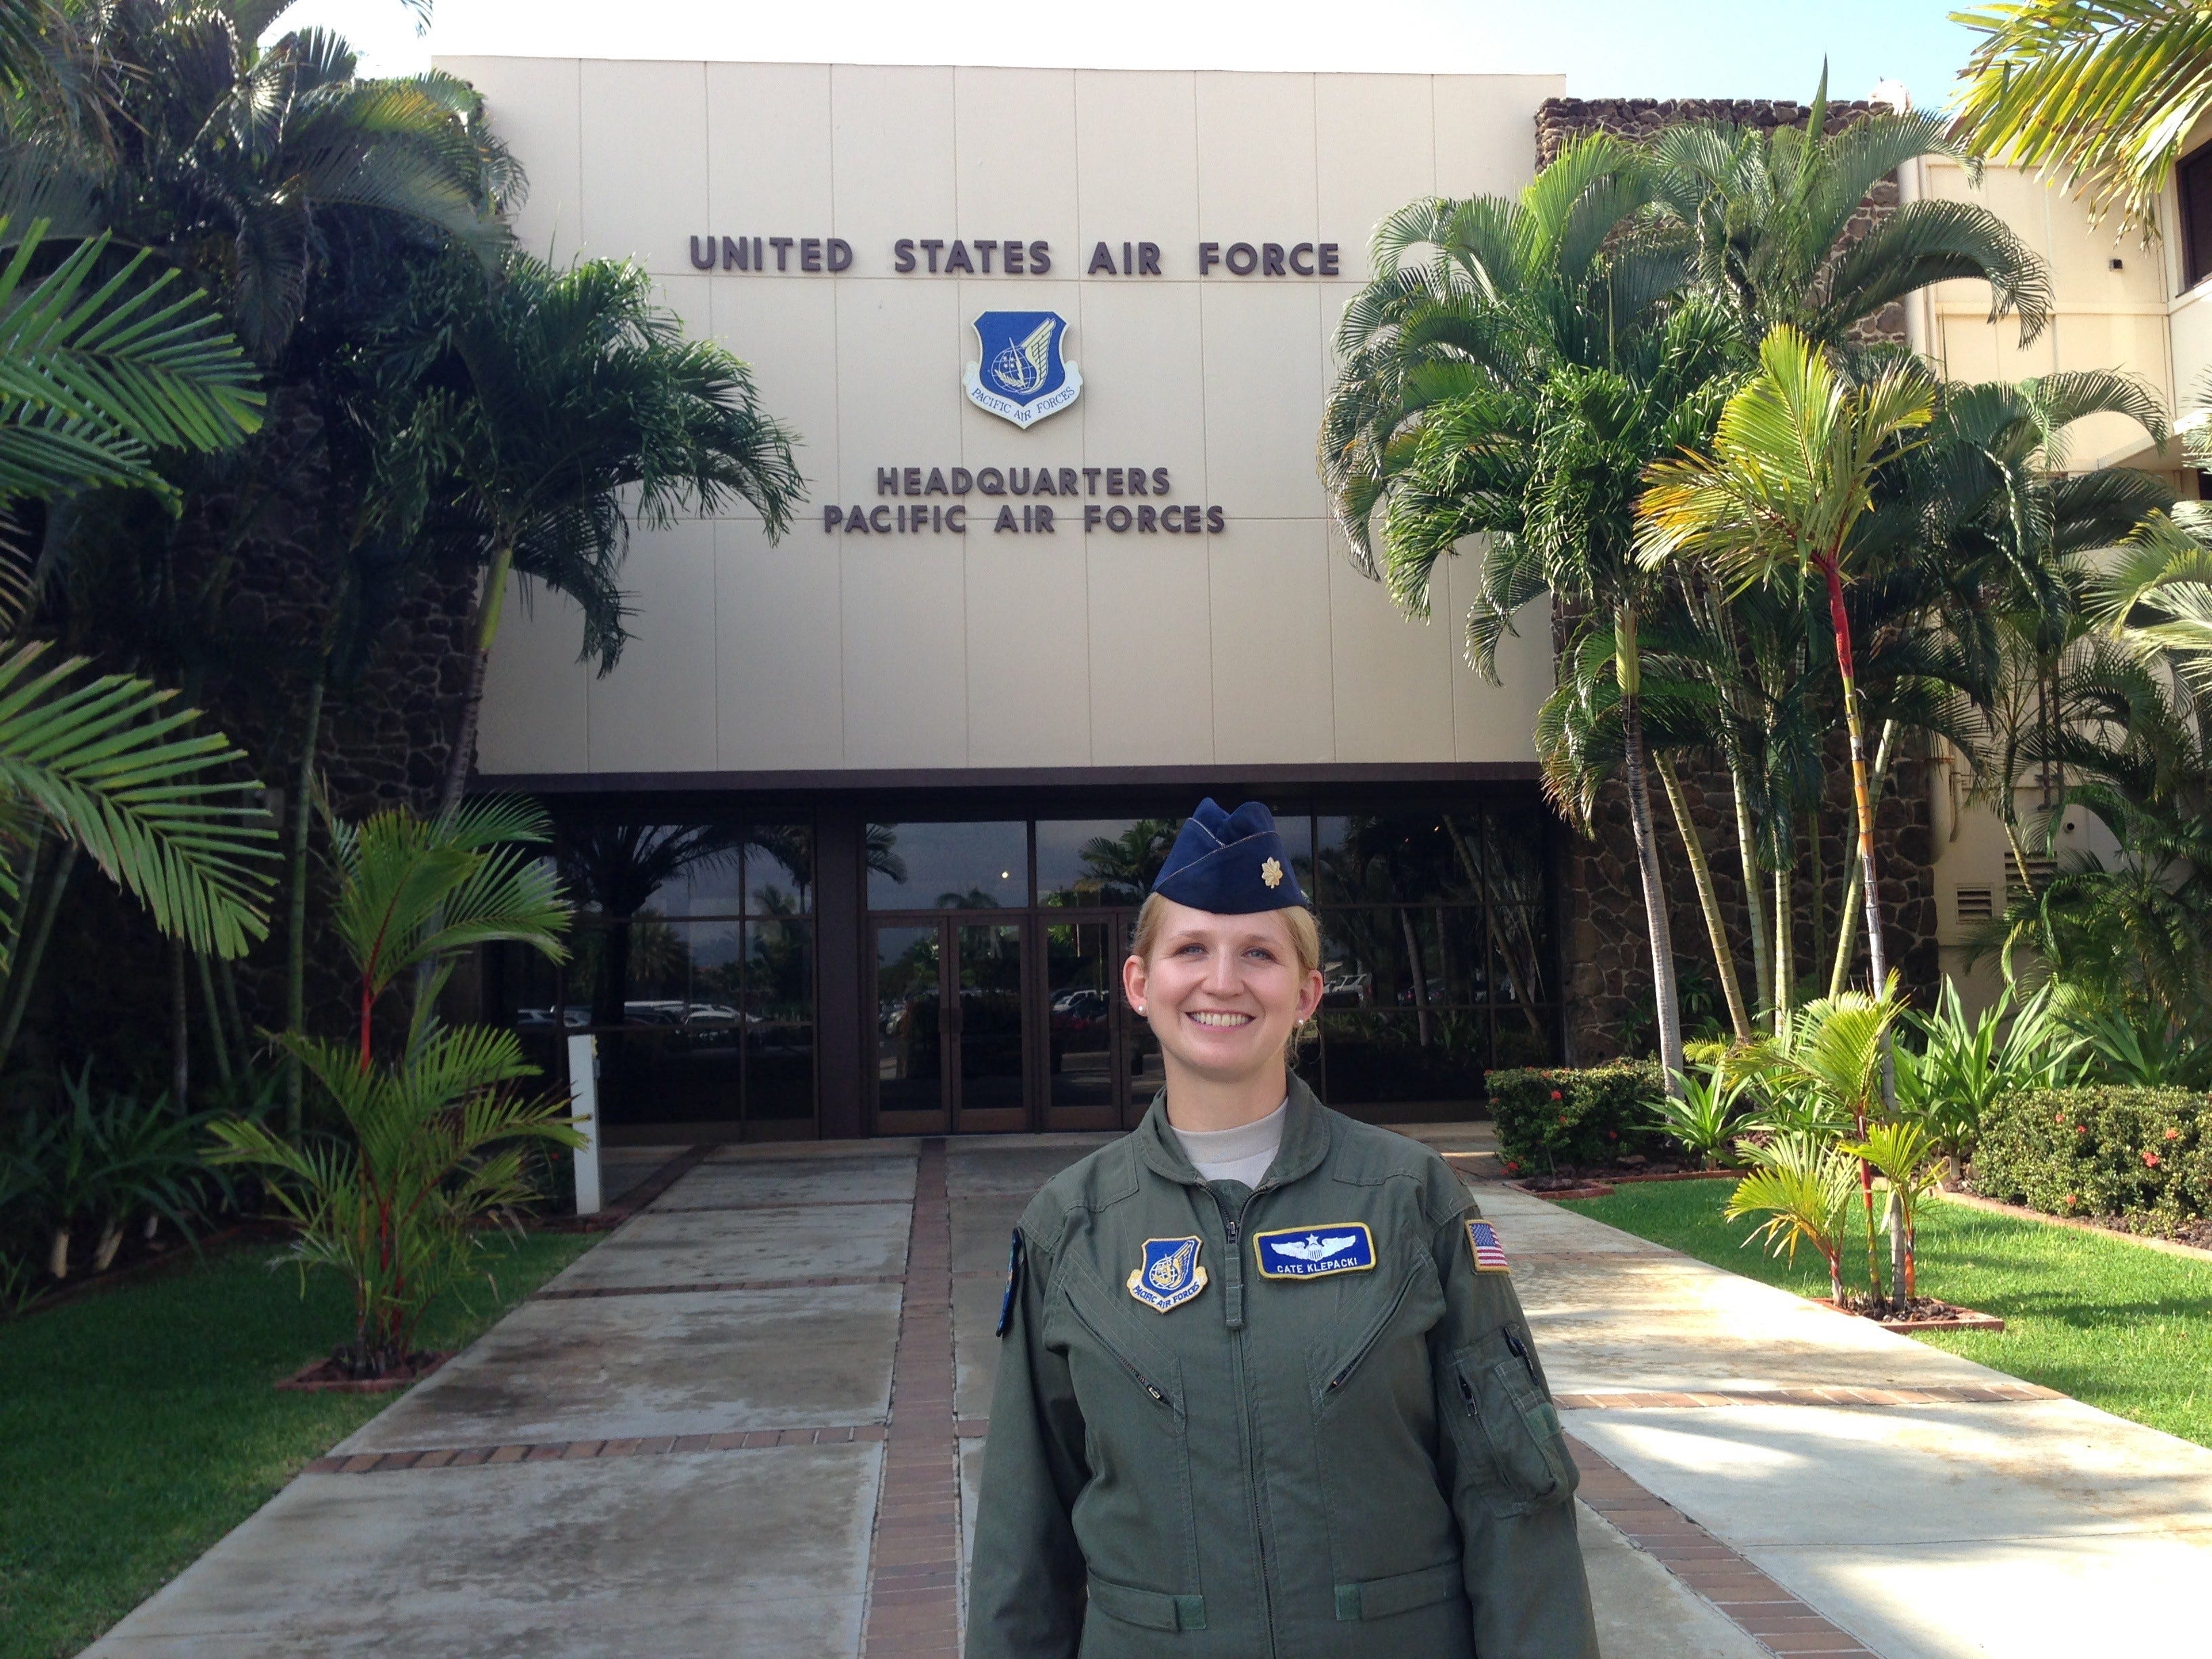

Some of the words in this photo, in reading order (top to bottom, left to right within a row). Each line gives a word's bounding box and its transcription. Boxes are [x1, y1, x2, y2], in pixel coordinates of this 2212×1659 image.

[689, 235, 854, 272] UNITED
[894, 239, 1051, 274] STATES
[1088, 241, 1162, 276] AIR
[1200, 242, 1340, 276] FORCE
[972, 388, 1012, 413] PACIFIC
[1014, 409, 1031, 422] AIR
[1037, 386, 1075, 413] FORCES
[876, 466, 1170, 495] HEADQUARTERS
[823, 504, 966, 533] PACIFIC
[994, 505, 1054, 533] AIR
[1084, 505, 1225, 534] FORCES
[1277, 1265, 1304, 1273] CATE
[1307, 1257, 1357, 1273] KLEPACKI
[1133, 1285, 1157, 1303] PACIFIC
[1157, 1299, 1171, 1309] AIR
[1173, 1282, 1200, 1303] FORCES
